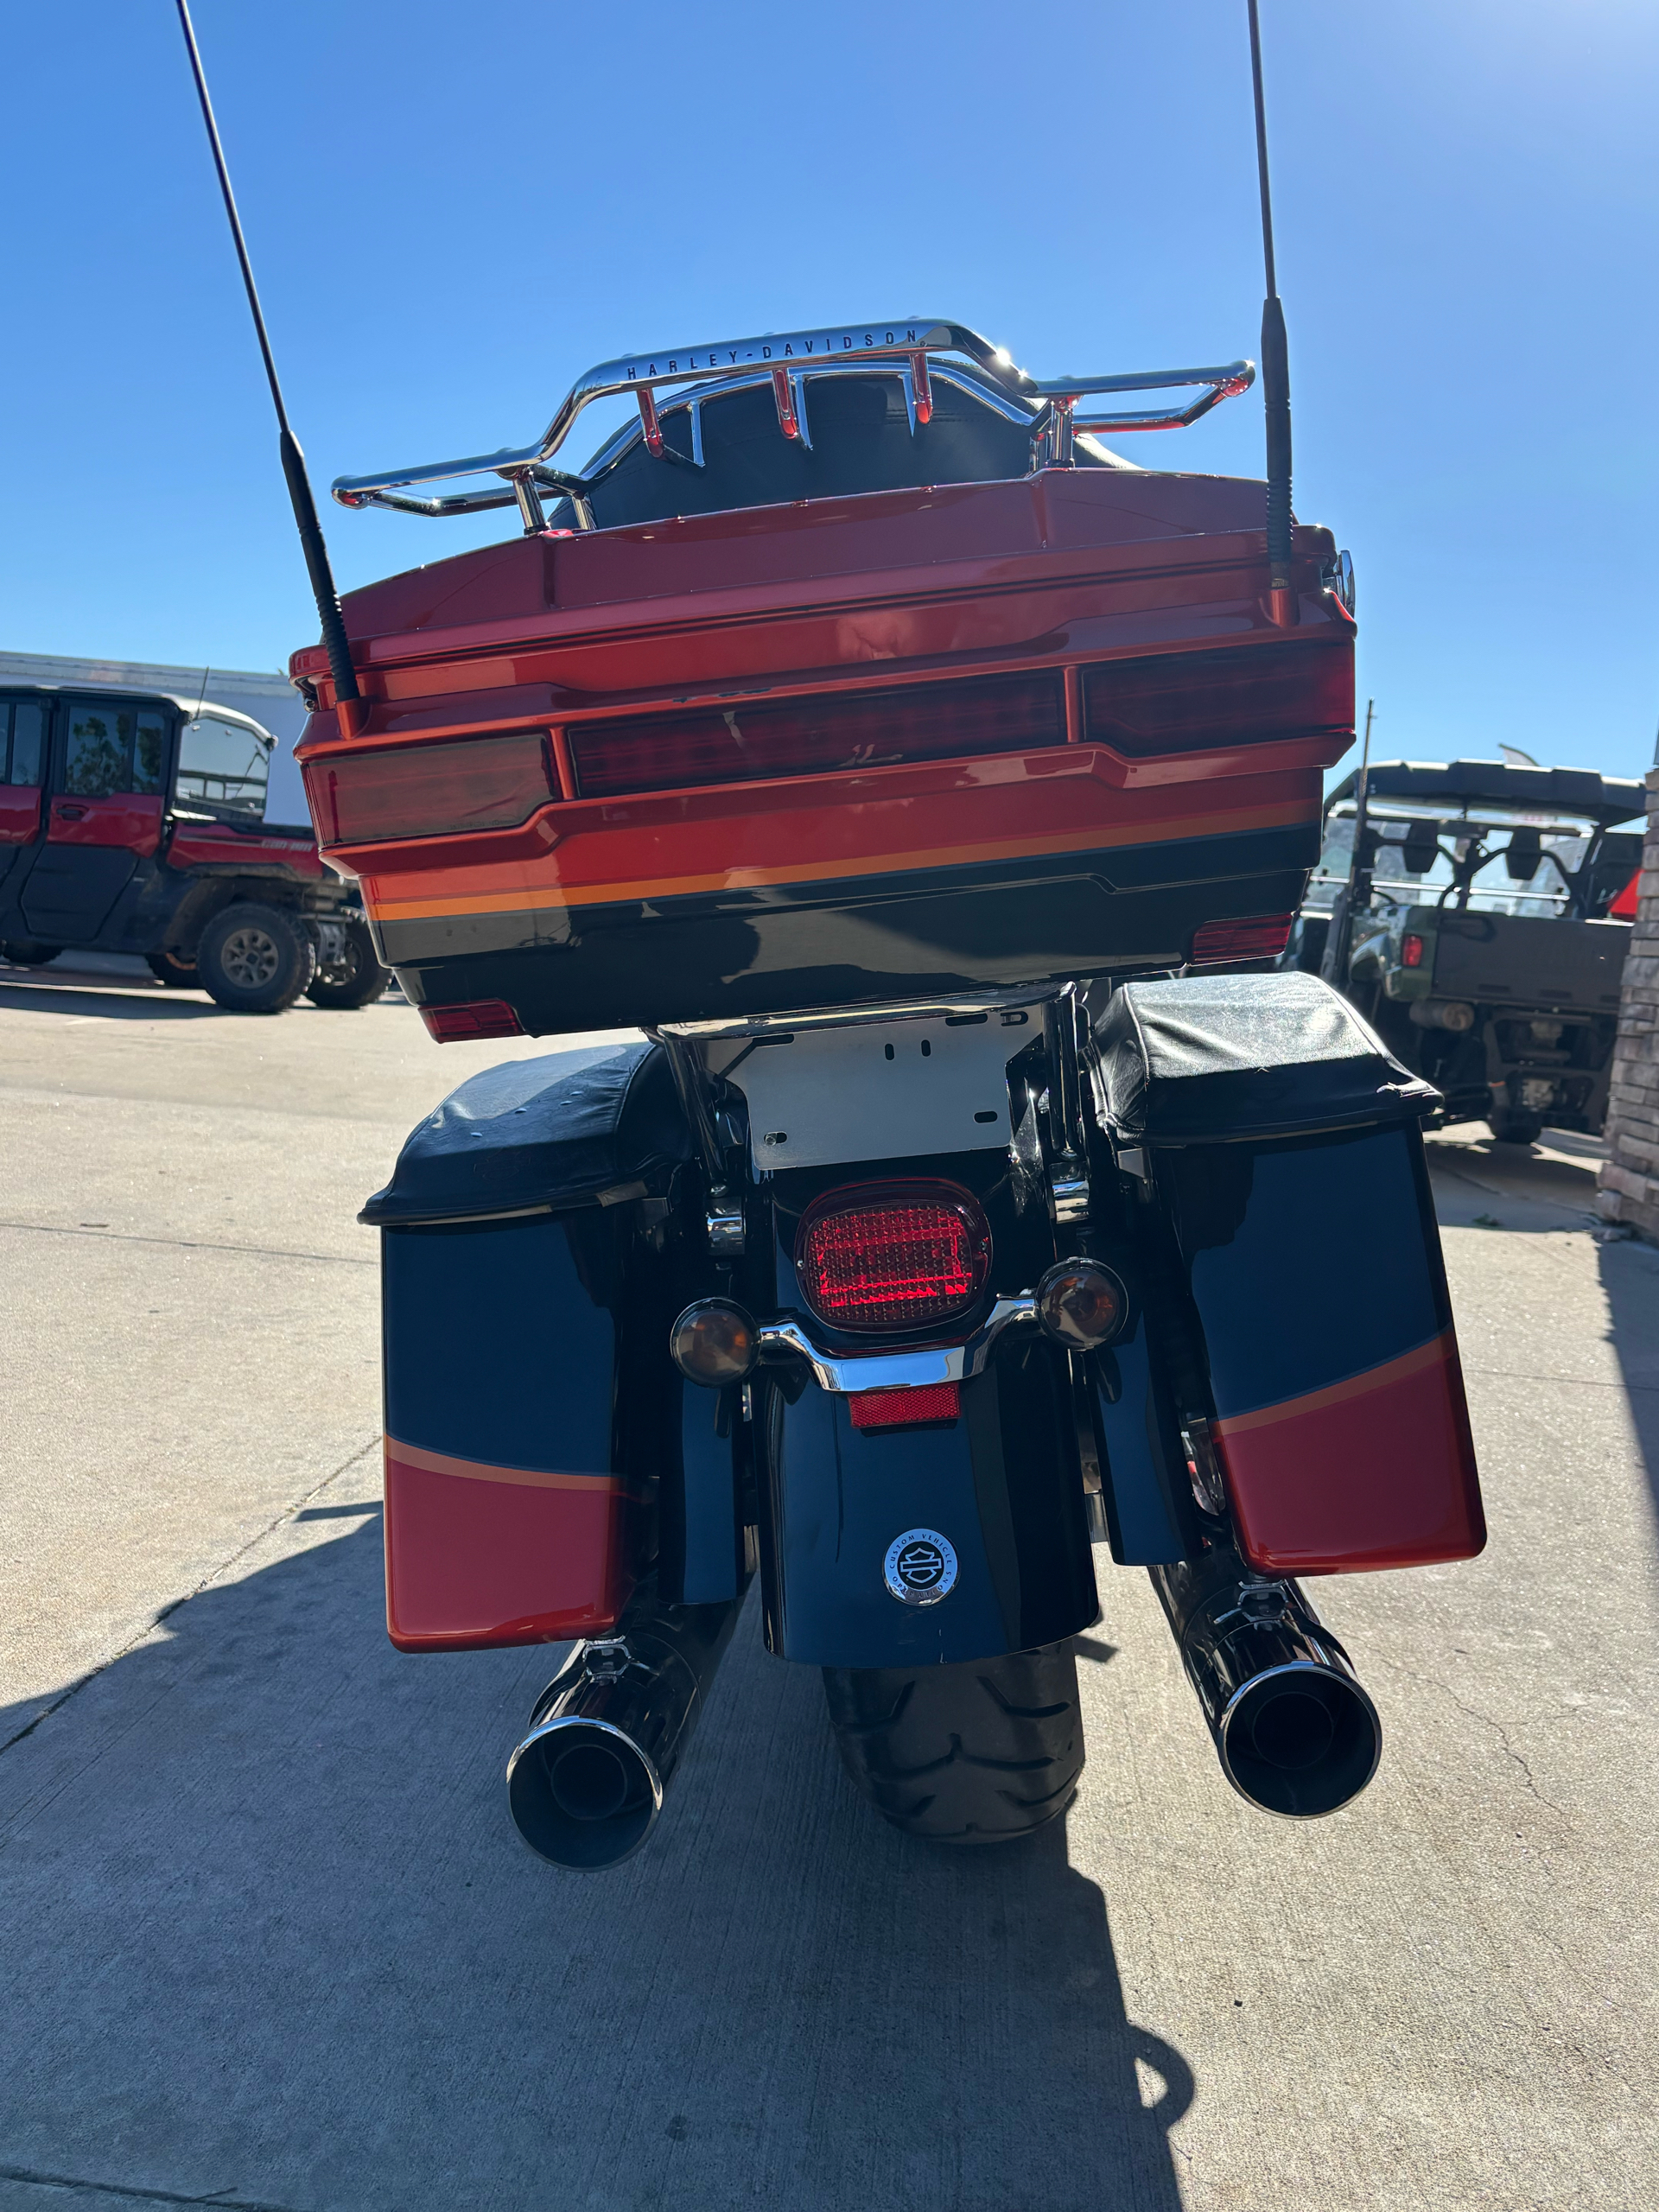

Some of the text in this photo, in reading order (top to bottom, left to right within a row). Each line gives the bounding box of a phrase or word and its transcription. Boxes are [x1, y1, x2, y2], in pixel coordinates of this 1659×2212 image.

[627, 329, 917, 380] HARLEY-DAVIDSON
[890, 1533, 952, 1569] CUSTOM VEHICLE
